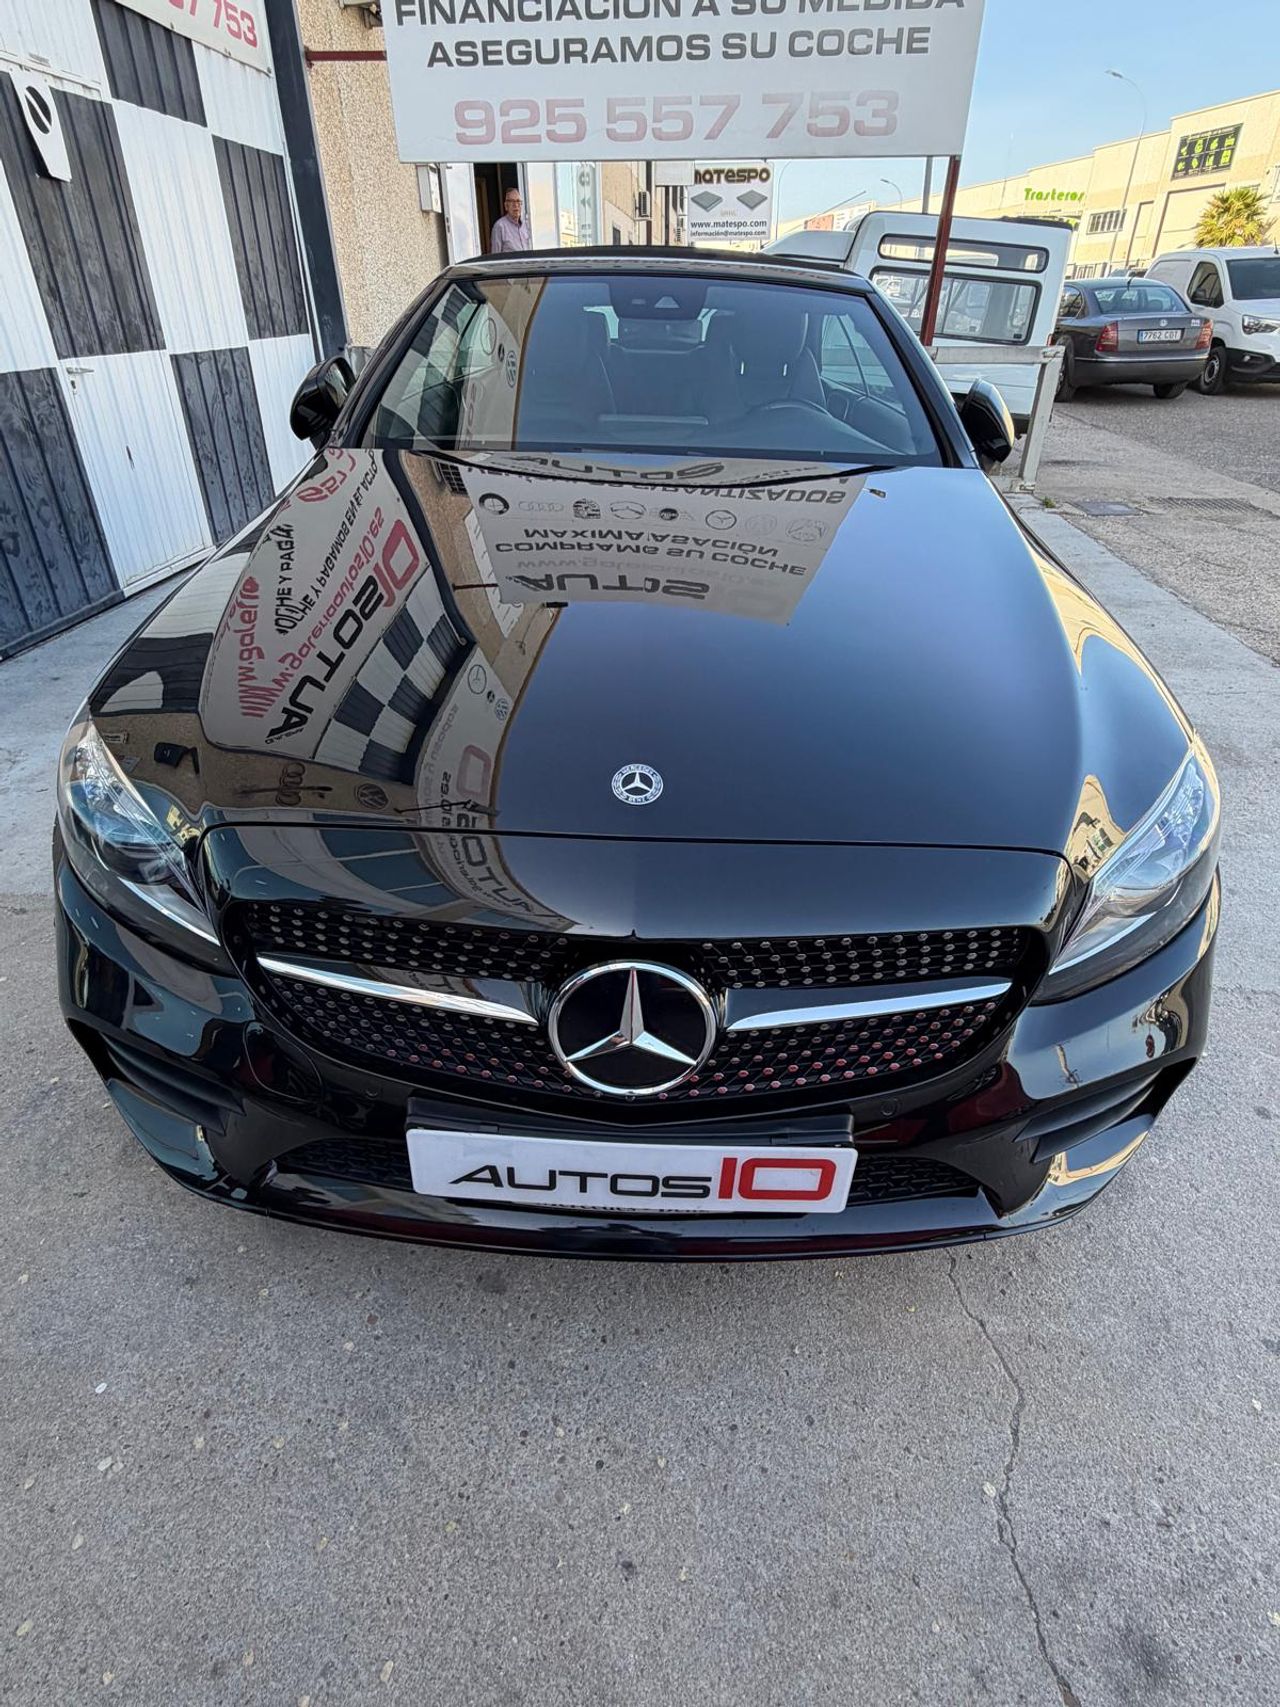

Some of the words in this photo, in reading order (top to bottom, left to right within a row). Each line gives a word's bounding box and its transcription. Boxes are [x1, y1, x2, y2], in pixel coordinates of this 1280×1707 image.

[427, 33, 711, 68] ASEGURAMOS
[722, 31, 777, 59] SU
[788, 26, 931, 58] COCHE
[454, 99, 587, 145] 925
[605, 94, 741, 142] 557
[762, 89, 900, 139] 753
[1024, 188, 1085, 201] Trasteros
[690, 220, 767, 230] www.matespo.com
[449, 1157, 837, 1201] AUTOS10
